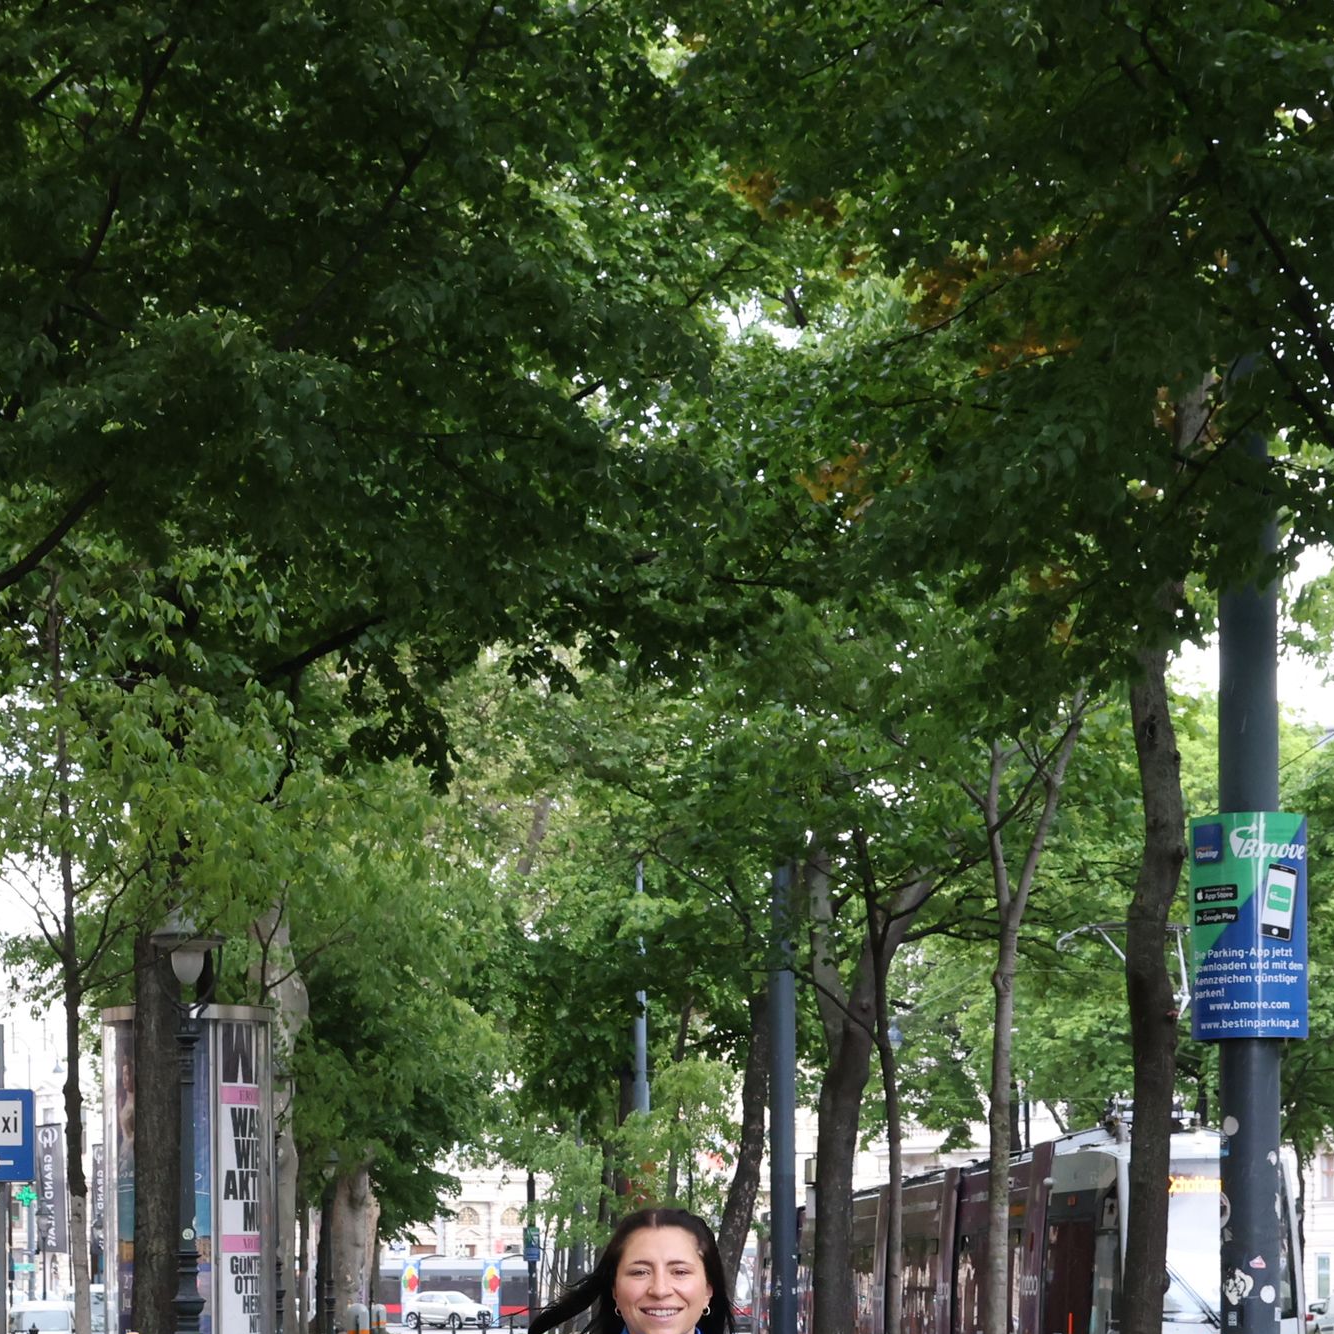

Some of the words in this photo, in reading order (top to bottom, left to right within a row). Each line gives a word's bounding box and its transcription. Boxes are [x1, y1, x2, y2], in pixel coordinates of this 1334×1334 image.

[1194, 951, 1206, 960] Die
[1207, 947, 1270, 959] Parking-App
[1272, 947, 1293, 958] jetzt
[1195, 961, 1247, 973] downloaden
[1249, 961, 1269, 970] und
[1272, 960, 1287, 969] mit
[1288, 961, 1303, 970] dem
[1194, 974, 1252, 986] Kennzeichen
[1254, 973, 1298, 985] günstiger
[1194, 988, 1225, 1001] parken!
[1209, 1000, 1290, 1011] www.bmove.com
[1200, 1018, 1300, 1030] www.bestinparking.at
